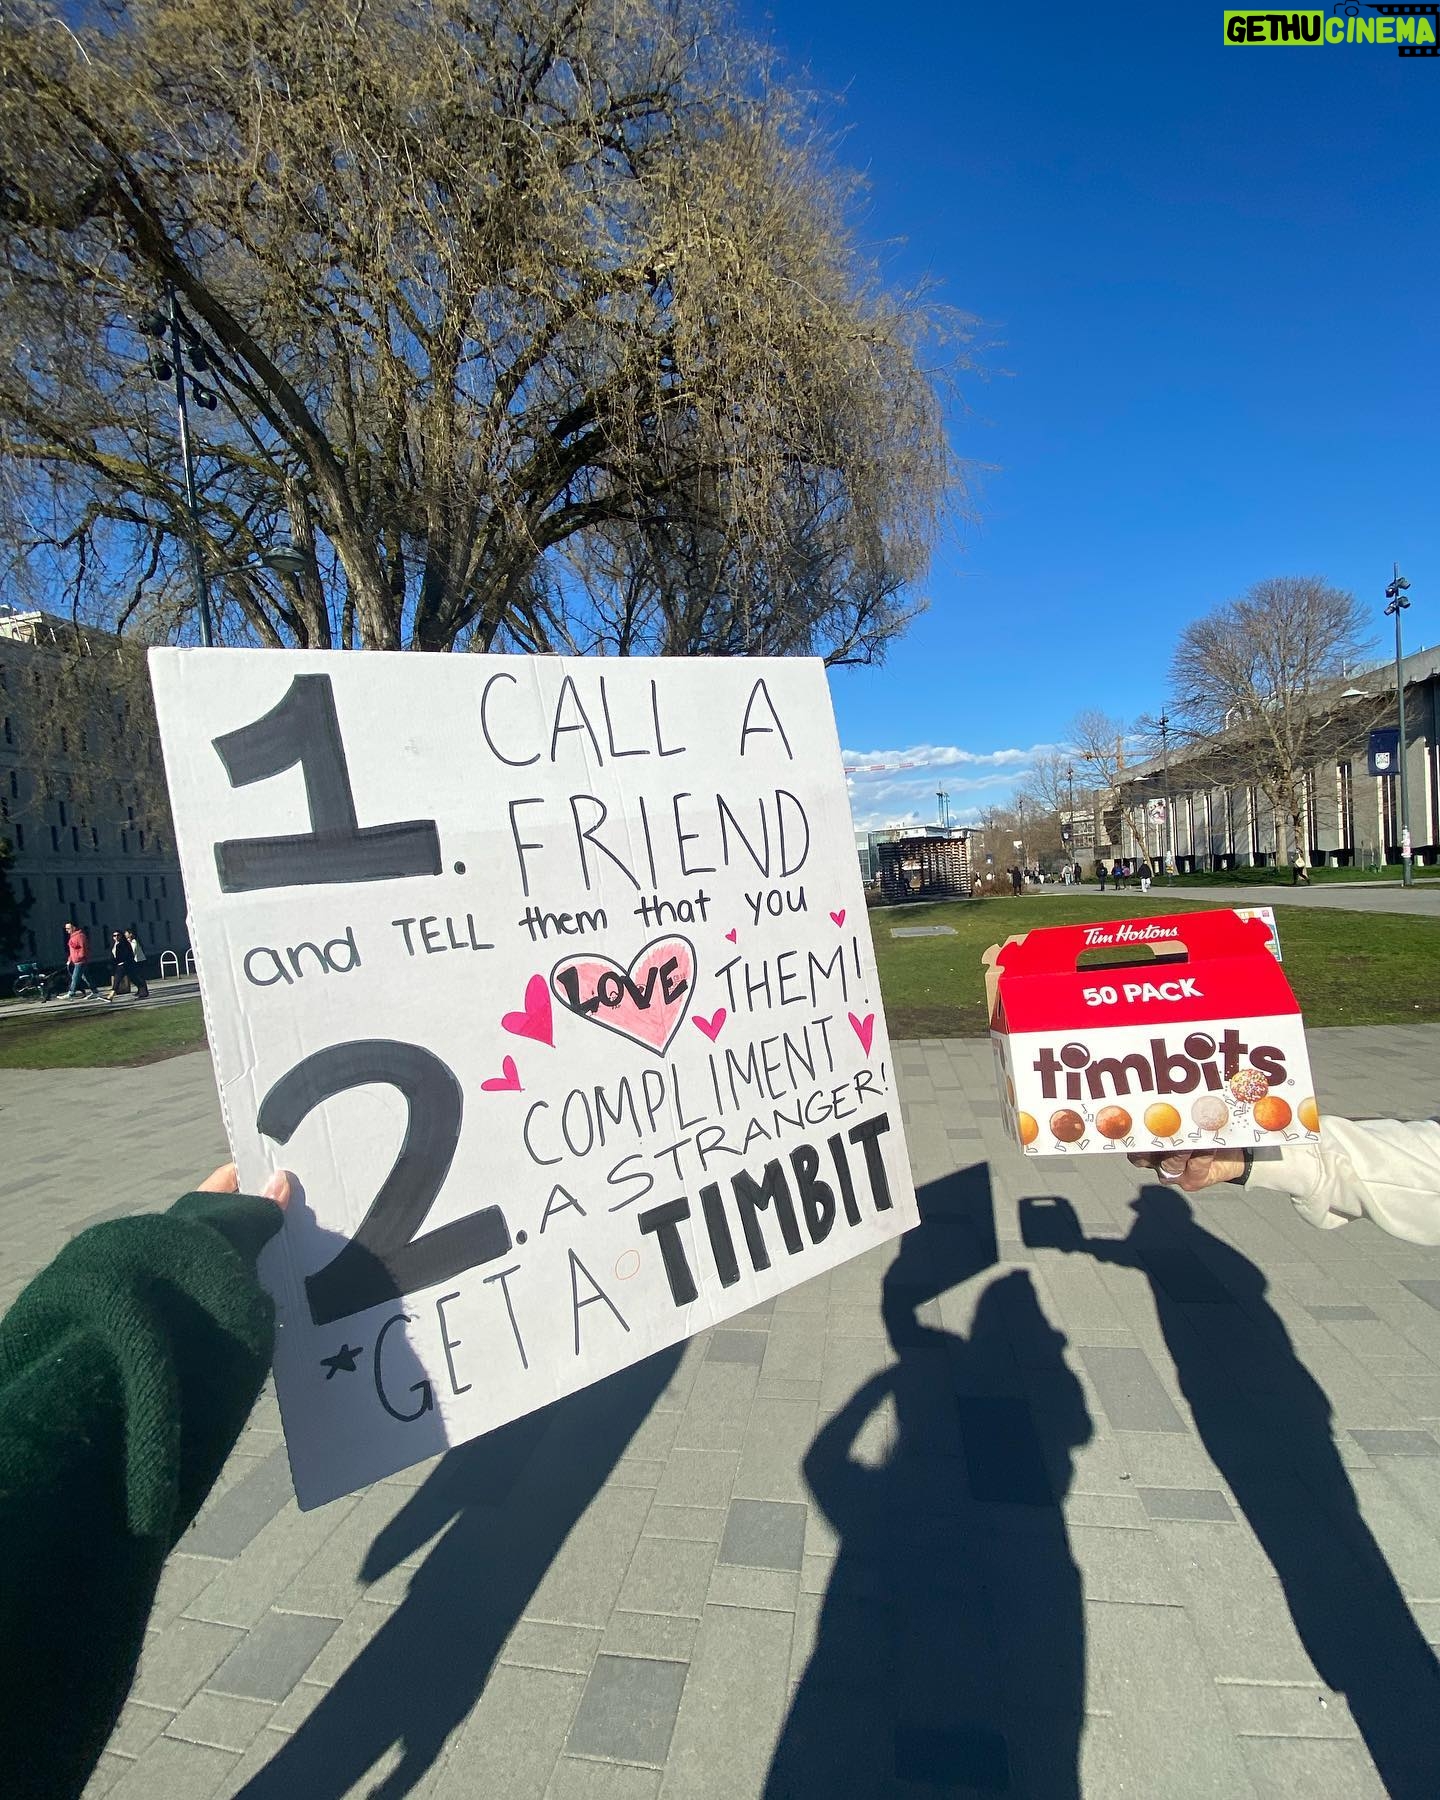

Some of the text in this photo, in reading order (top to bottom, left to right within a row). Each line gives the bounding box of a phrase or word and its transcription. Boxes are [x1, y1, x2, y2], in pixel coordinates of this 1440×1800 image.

[481, 672, 793, 767] CALL A
[509, 789, 810, 897] FRIEND
[243, 887, 808, 987] and TELL them that you
[556, 936, 871, 1016] LOVE THEM!
[1083, 923, 1179, 946] Tim Hortons
[1082, 977, 1205, 1007] 50 PACK
[522, 1015, 835, 1166] COMPLIMENT
[1033, 1028, 1288, 1101] timbits
[539, 1062, 889, 1235] A STRANGER!
[374, 1112, 893, 1422] GET A TIMBIT
